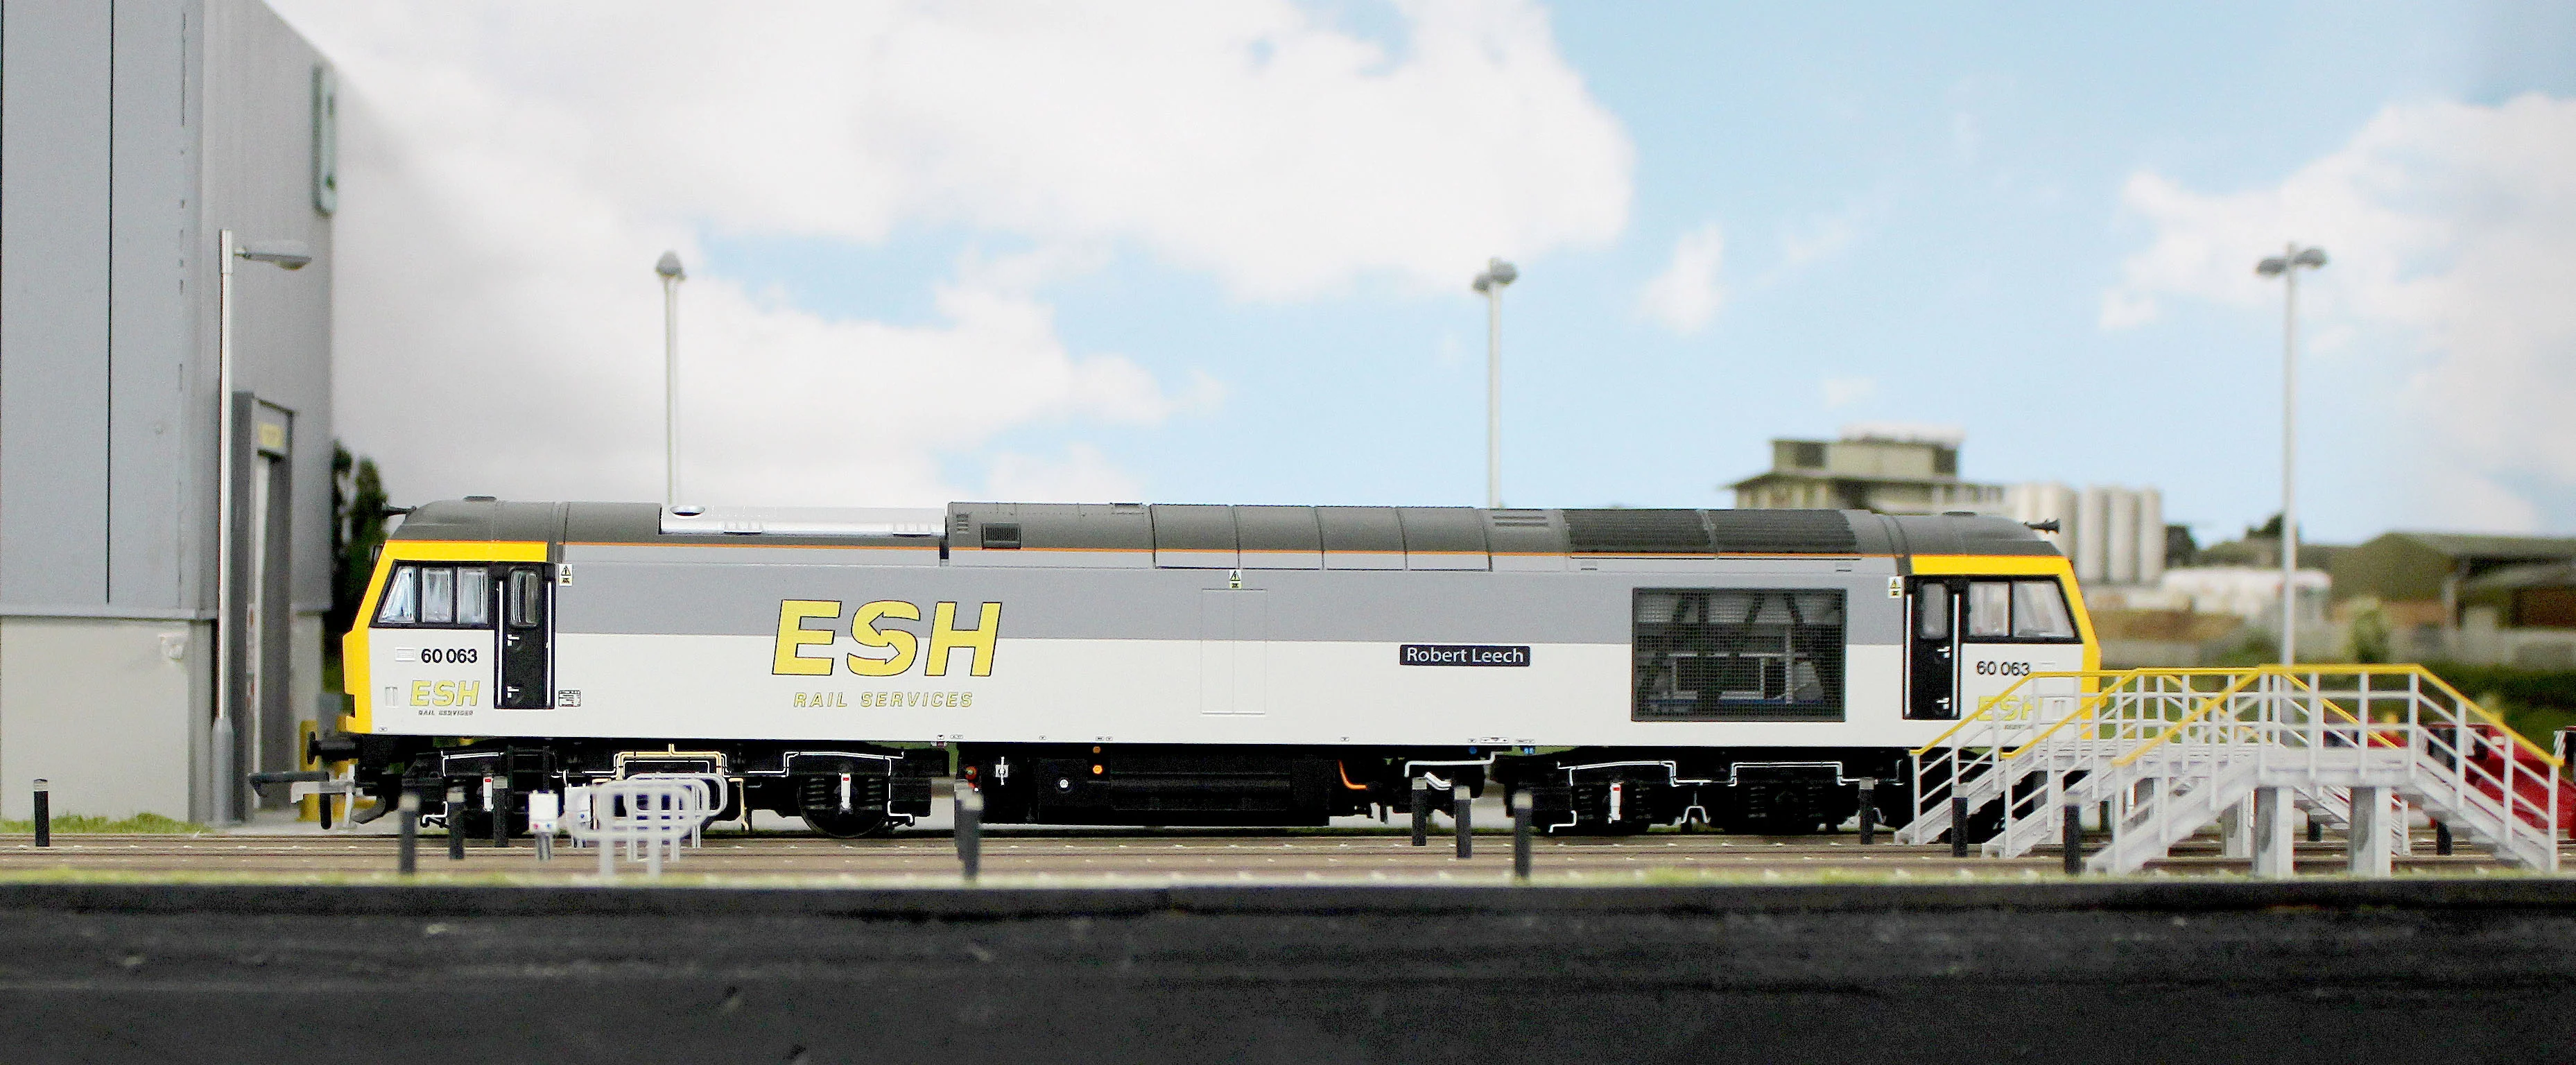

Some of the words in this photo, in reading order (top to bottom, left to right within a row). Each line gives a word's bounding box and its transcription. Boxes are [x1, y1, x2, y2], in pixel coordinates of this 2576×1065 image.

[772, 599, 1003, 677] ESH
[421, 648, 443, 664] 60
[446, 648, 478, 664] 063
[1406, 647, 1467, 663] Robert
[1471, 648, 1524, 663] Leech
[1976, 661, 1996, 675] 60
[2000, 661, 2030, 676] 063
[410, 679, 481, 706] ESH
[793, 691, 848, 707] RAIL
[861, 691, 974, 708] SERVICES
